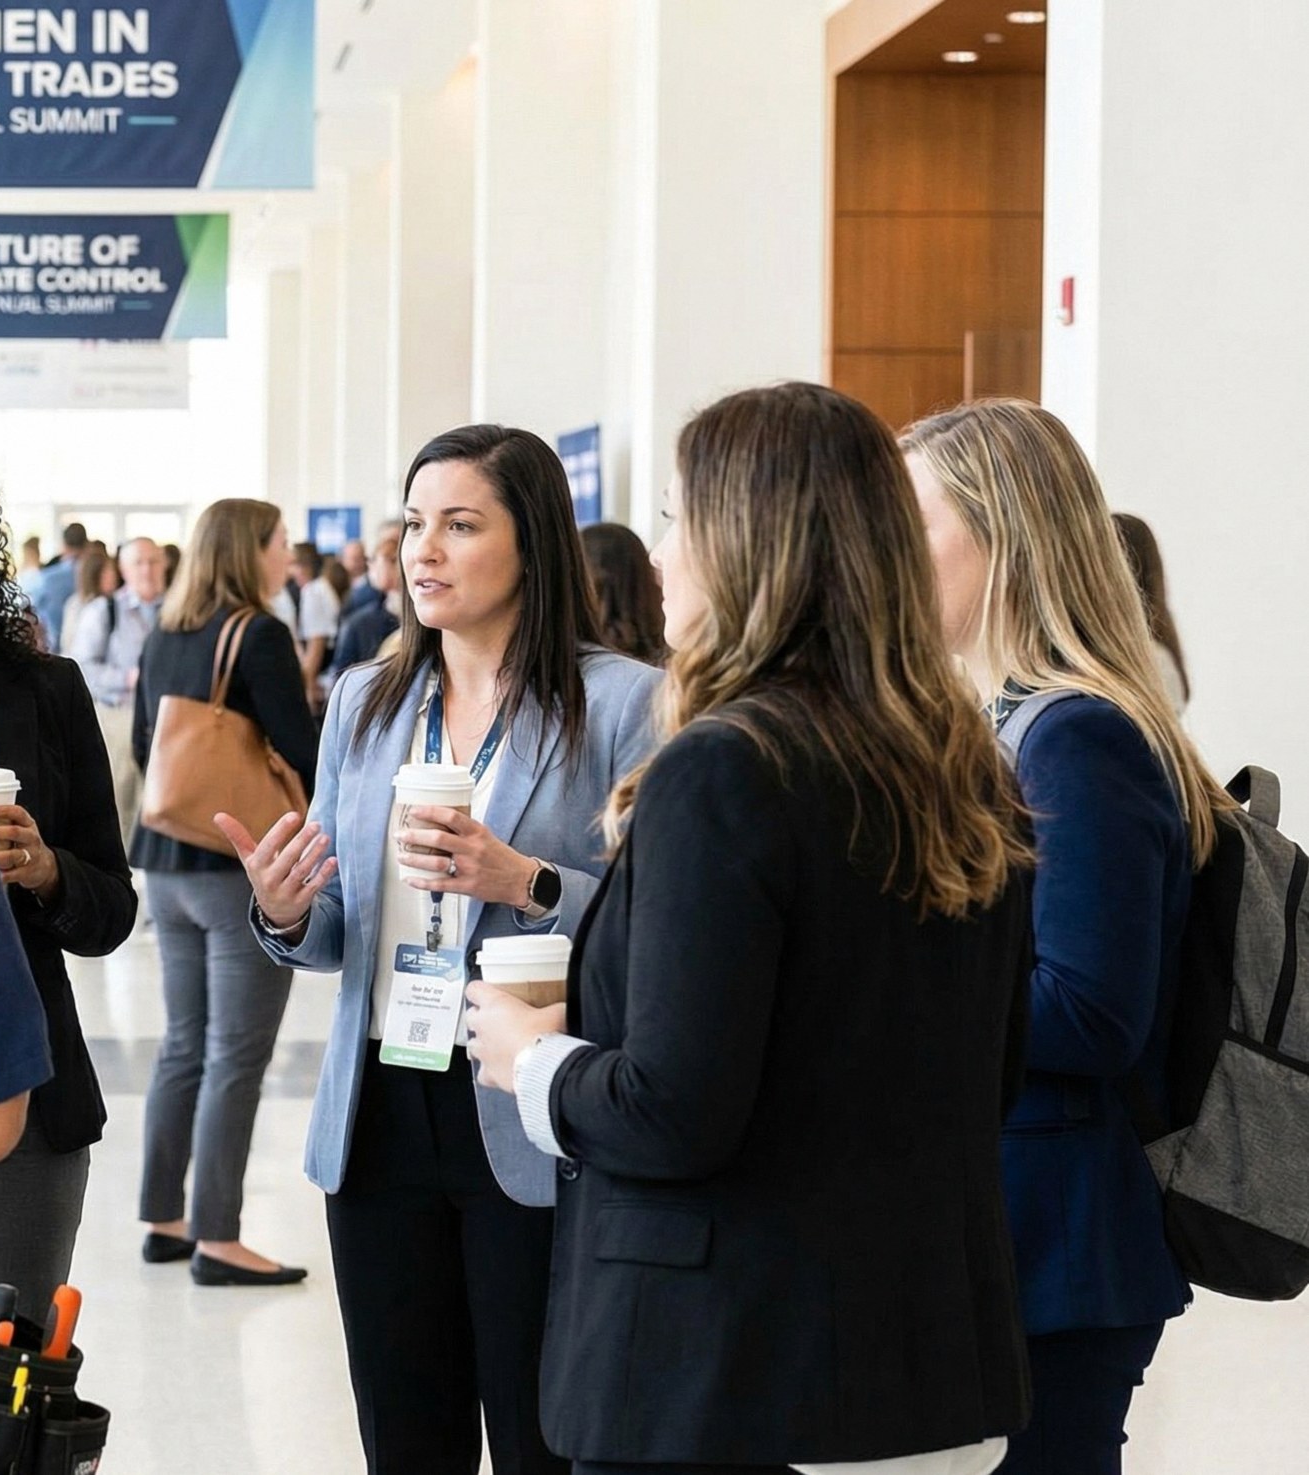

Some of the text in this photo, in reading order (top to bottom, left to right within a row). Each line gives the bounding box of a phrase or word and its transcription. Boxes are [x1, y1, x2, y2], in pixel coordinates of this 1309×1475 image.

[92, 9, 149, 54] IN
[4, 61, 180, 99] TRADES
[9, 108, 122, 134] SUMMIT
[90, 235, 140, 265] OF
[37, 267, 168, 293] CONTROL
